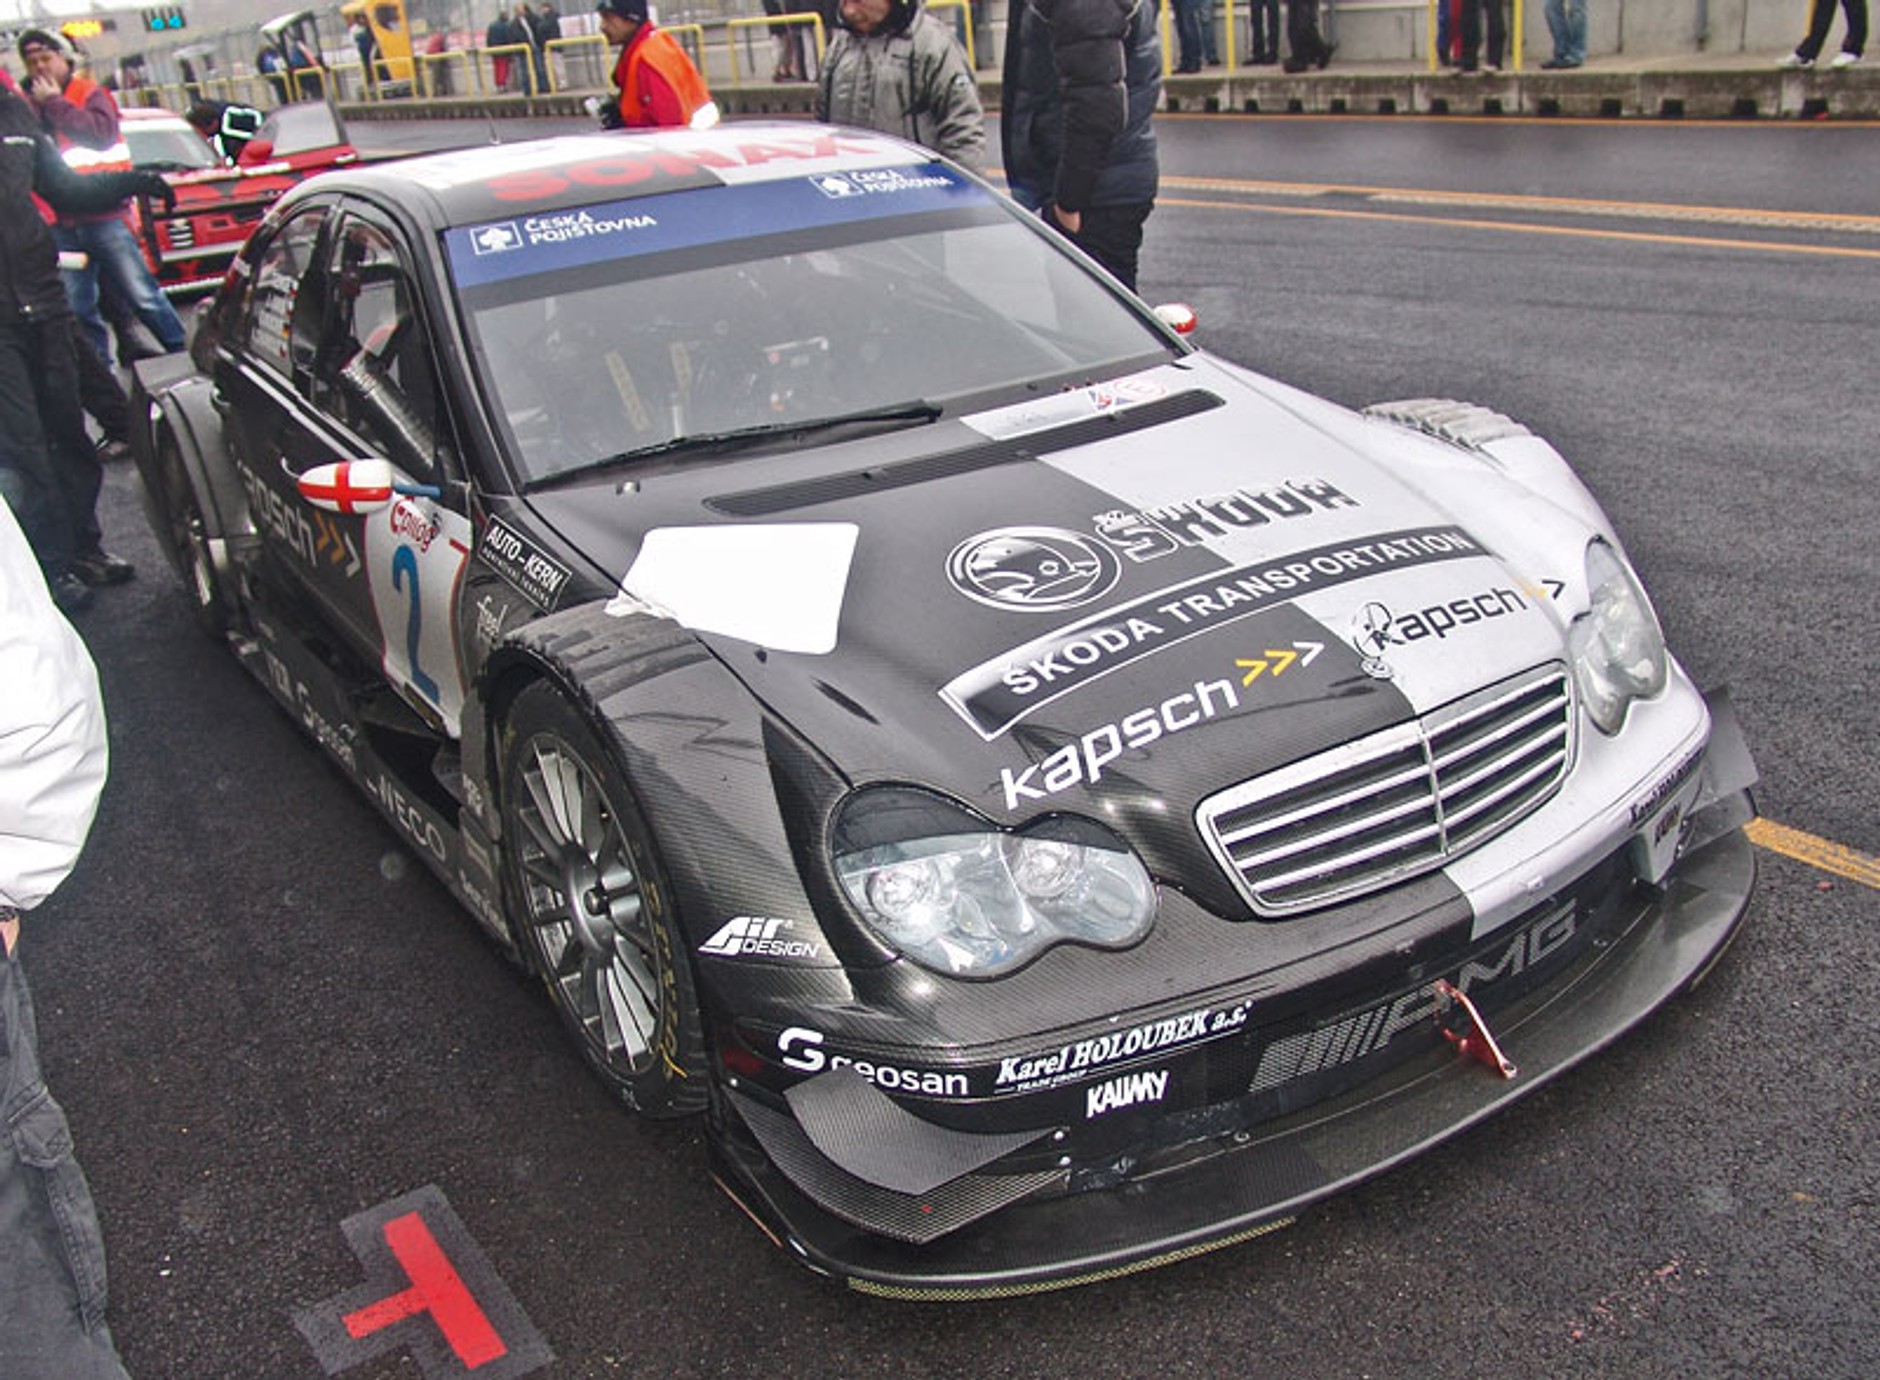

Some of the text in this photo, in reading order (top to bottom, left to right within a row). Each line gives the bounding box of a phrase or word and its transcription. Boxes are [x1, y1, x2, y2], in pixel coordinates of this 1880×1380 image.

[487, 132, 877, 201] SONAX
[1159, 529, 1477, 625] TRANSPORTATION
[392, 544, 442, 705] 2
[1000, 678, 1240, 811] kapsch
[742, 939, 822, 958] DESIGN
[995, 1046, 1071, 1085] Karel
[1069, 1009, 1213, 1070] HOLOUBEK
